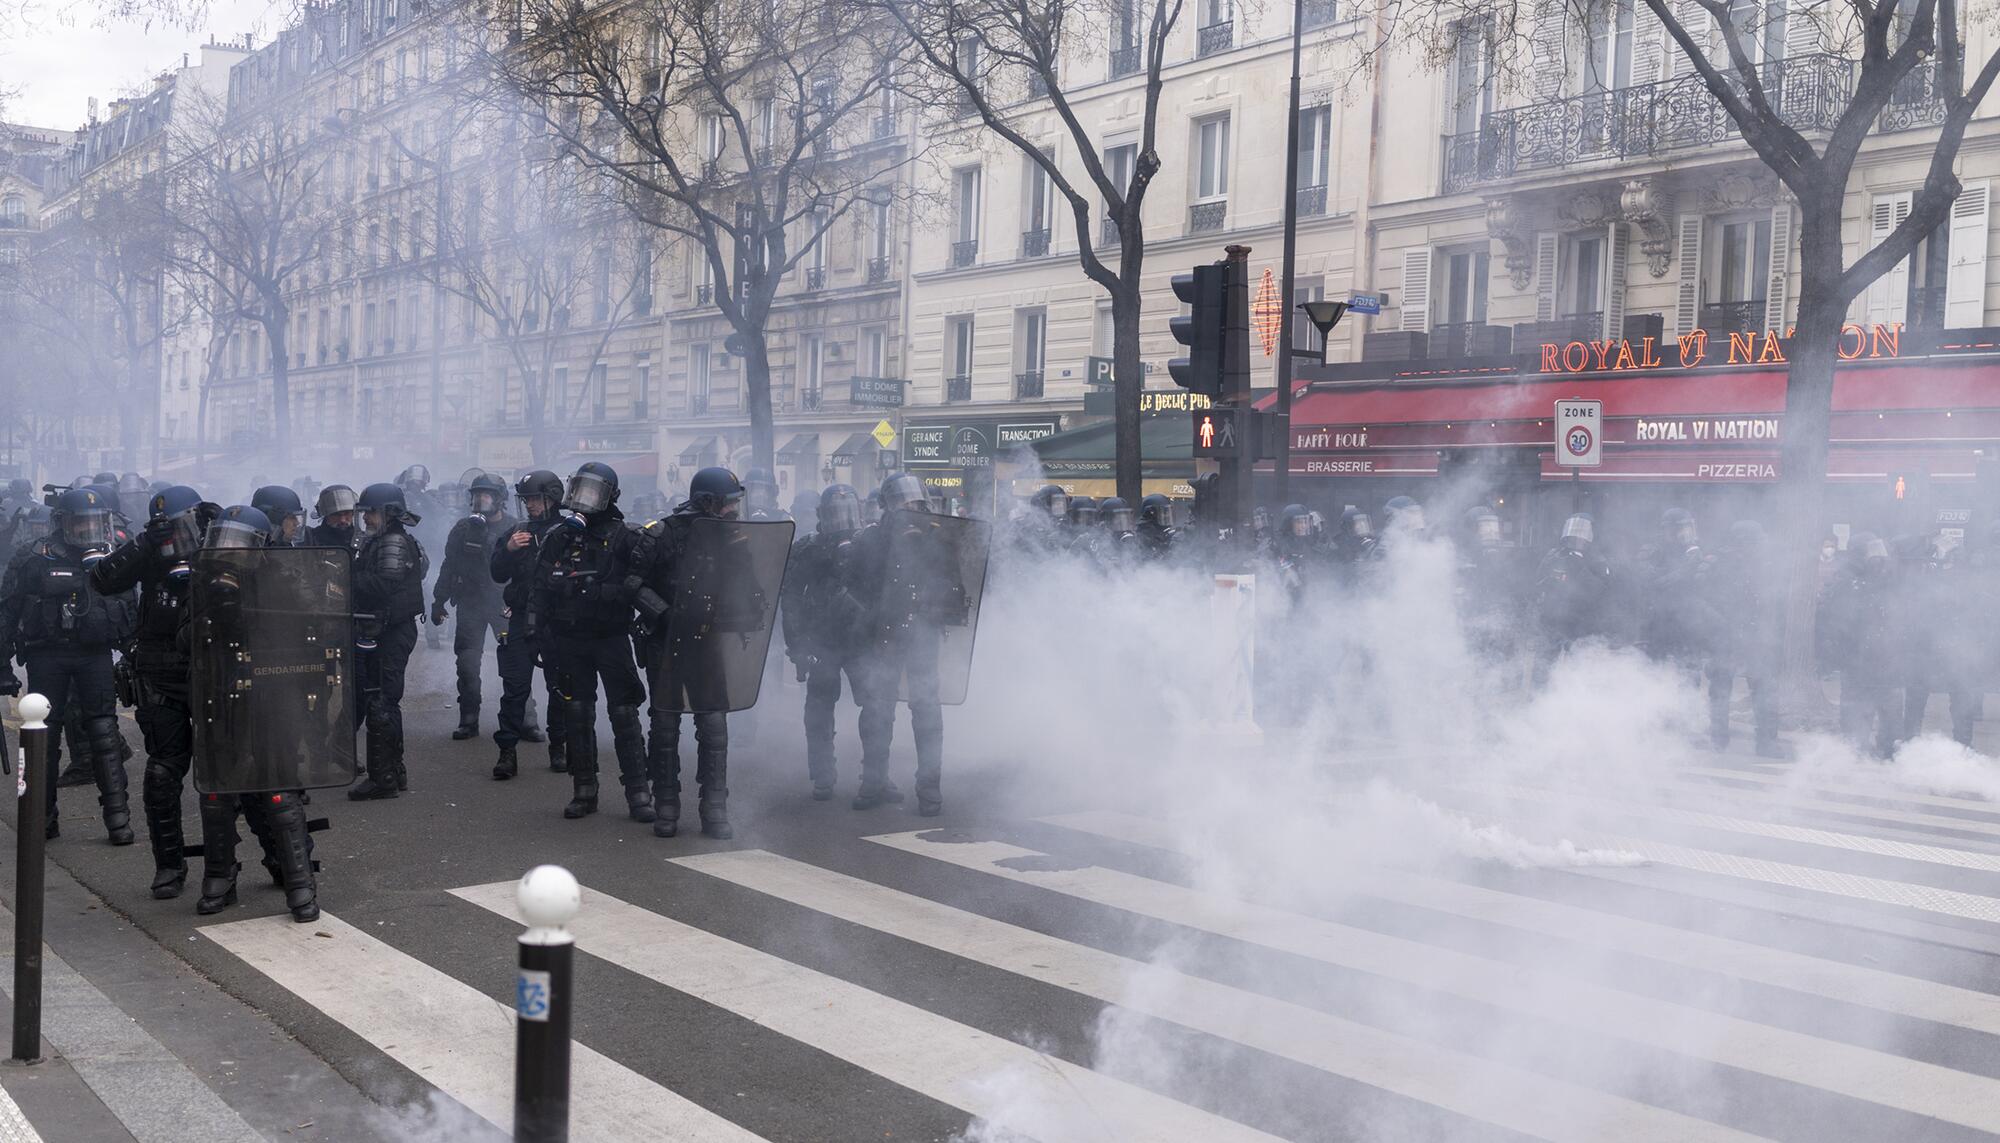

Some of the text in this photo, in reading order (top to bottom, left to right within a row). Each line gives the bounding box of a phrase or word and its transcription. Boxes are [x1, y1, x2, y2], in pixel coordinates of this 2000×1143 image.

[1539, 322, 1904, 373] ROYAL VI NAON
[860, 381, 898, 392] LE DOME
[854, 392, 902, 403] IMMOBILIER
[1140, 393, 1211, 411] LE DECLIC PUB
[1565, 408, 1594, 417] ZONE
[1001, 430, 1050, 441] TRANSACTION
[1636, 420, 1778, 440] ROYAL VI NATION
[911, 431, 943, 442] GERANCE
[963, 431, 971, 442] LE
[1297, 433, 1368, 448] HAPPY HOUR
[1571, 435, 1588, 449] 30
[914, 446, 939, 457] SYNDIC
[957, 444, 979, 454] DOME
[950, 456, 990, 466] IMMOBILIER
[1307, 461, 1372, 472] BRASSERIE
[1698, 464, 1776, 477] PIZZERIA
[1172, 484, 1193, 494] PIZZA
[254, 664, 325, 675] GENDARMERIE
